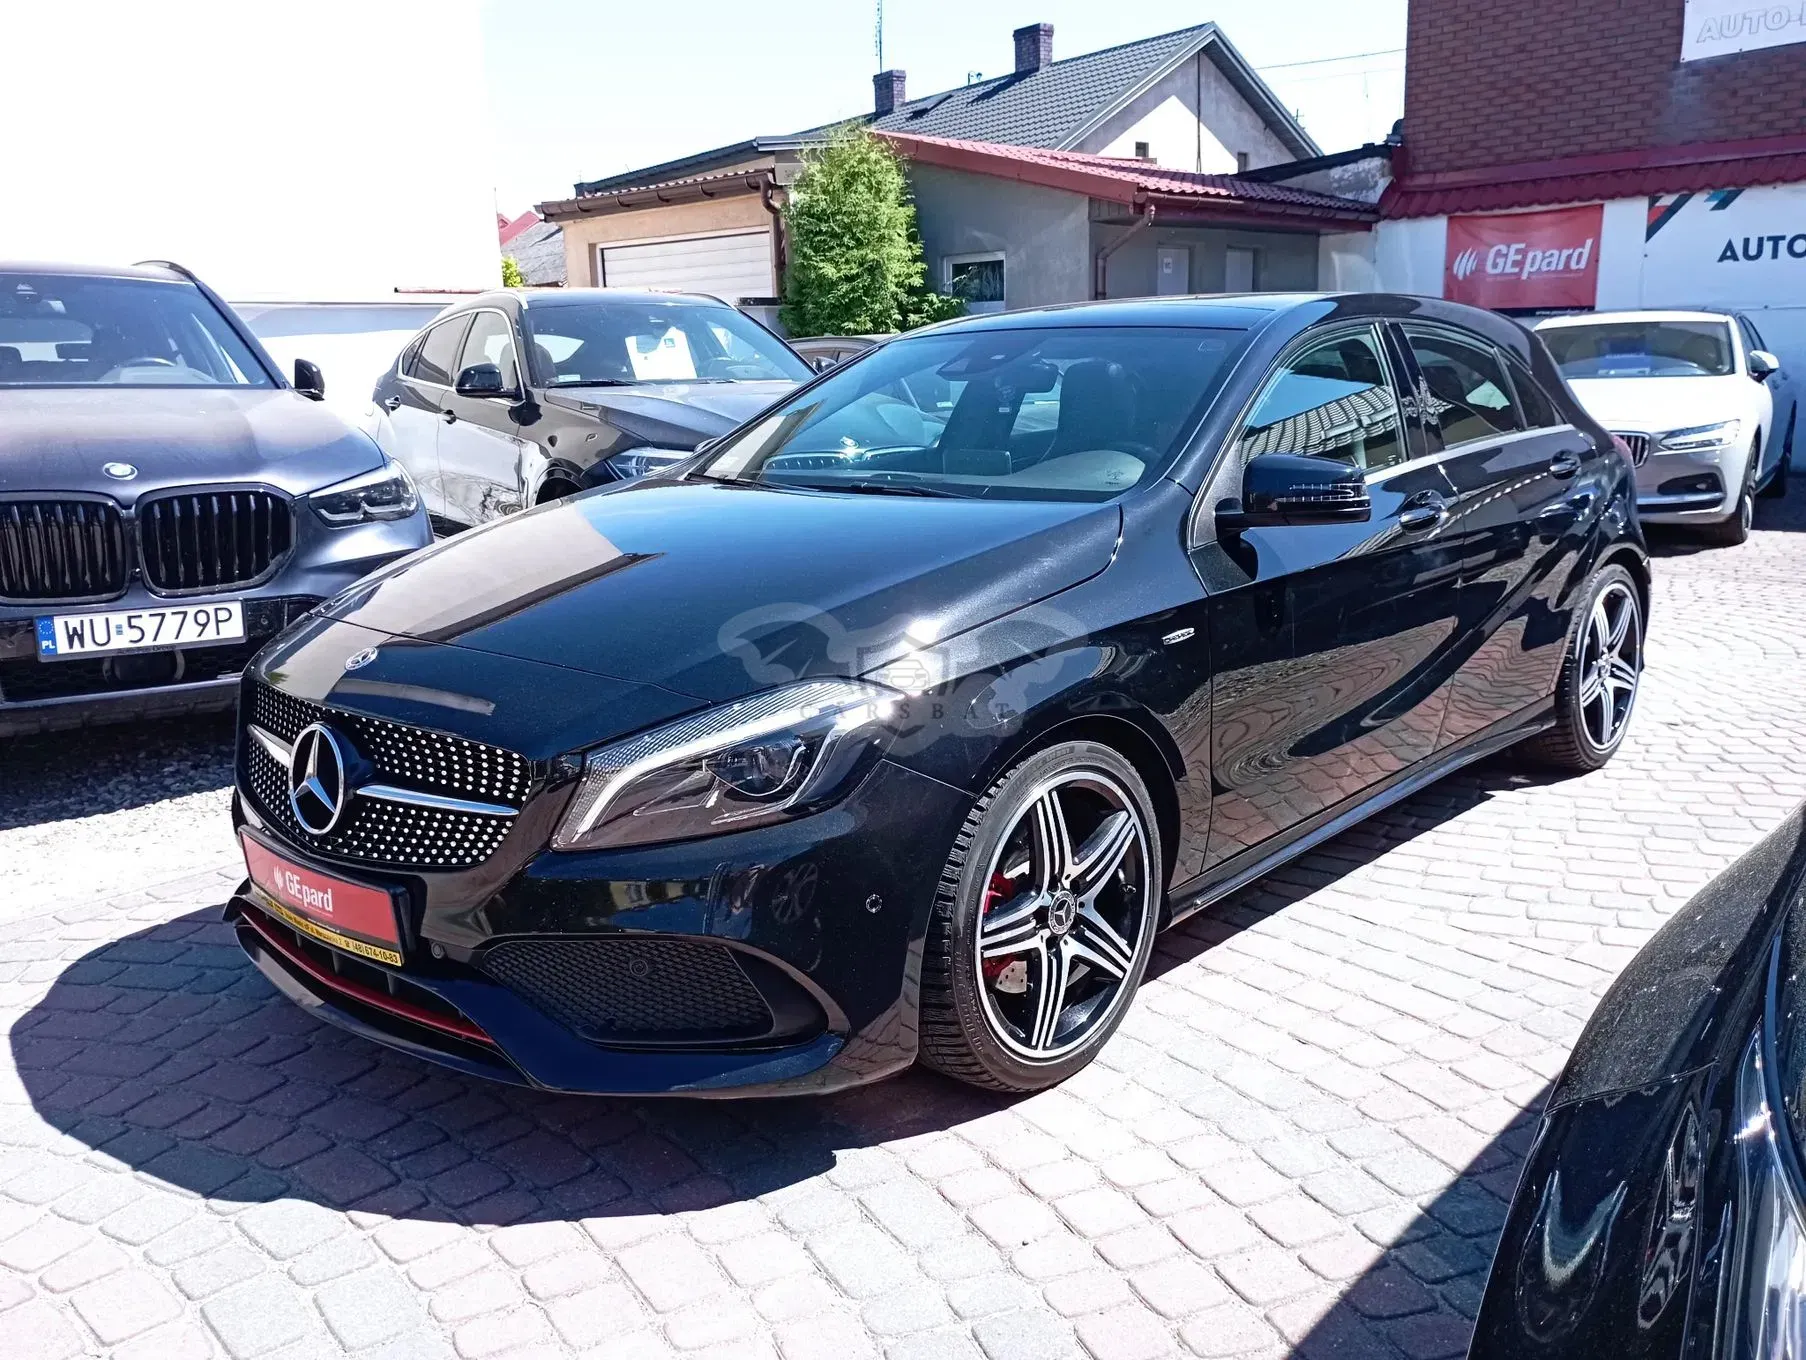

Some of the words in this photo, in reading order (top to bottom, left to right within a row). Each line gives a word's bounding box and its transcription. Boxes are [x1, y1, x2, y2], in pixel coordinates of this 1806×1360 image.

[1696, 0, 1806, 43] AUTO-
[1486, 238, 1594, 280] GEpard
[1717, 234, 1806, 263] AUTO
[41, 640, 56, 650] PL
[64, 617, 111, 649] WU
[127, 607, 233, 644] 5779P
[285, 871, 333, 912] GEpard
